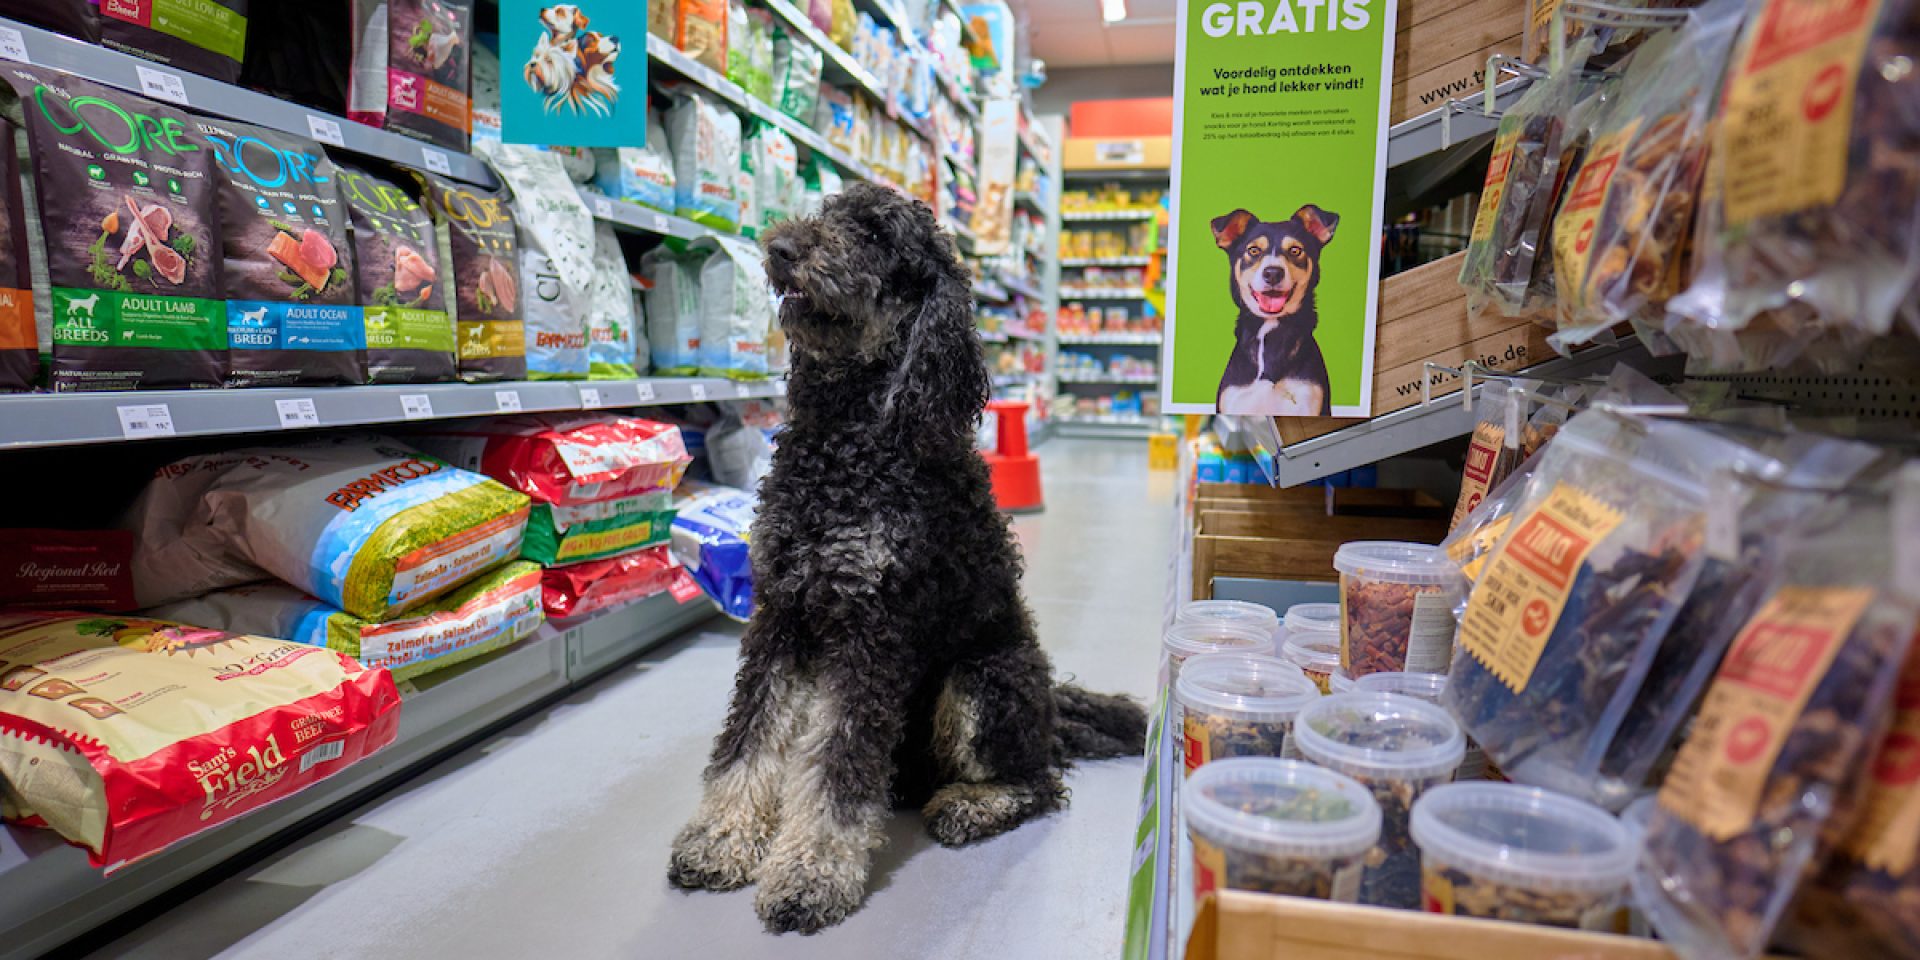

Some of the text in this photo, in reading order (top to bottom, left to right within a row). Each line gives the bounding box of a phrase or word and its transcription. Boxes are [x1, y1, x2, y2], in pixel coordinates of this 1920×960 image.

[1201, 0, 1371, 38] GRATIS
[1213, 63, 1352, 81] Voordelig ontdekken
[1199, 77, 1364, 97] wat je hond lekker vindt!
[34, 84, 200, 156] CORE
[203, 135, 330, 188] CORE
[121, 297, 196, 314] ADULT LAMB
[286, 307, 348, 321] ADULT OCEAN
[66, 316, 96, 329] ALL
[53, 329, 110, 342] BREEDS
[233, 333, 273, 345] BREED
[1521, 518, 1573, 565] TIMO
[16, 561, 121, 581] Regional Red
[386, 632, 434, 654] Zalmolie
[294, 722, 327, 743] BEEF
[187, 747, 238, 778] Sam's
[197, 732, 287, 810] Field
